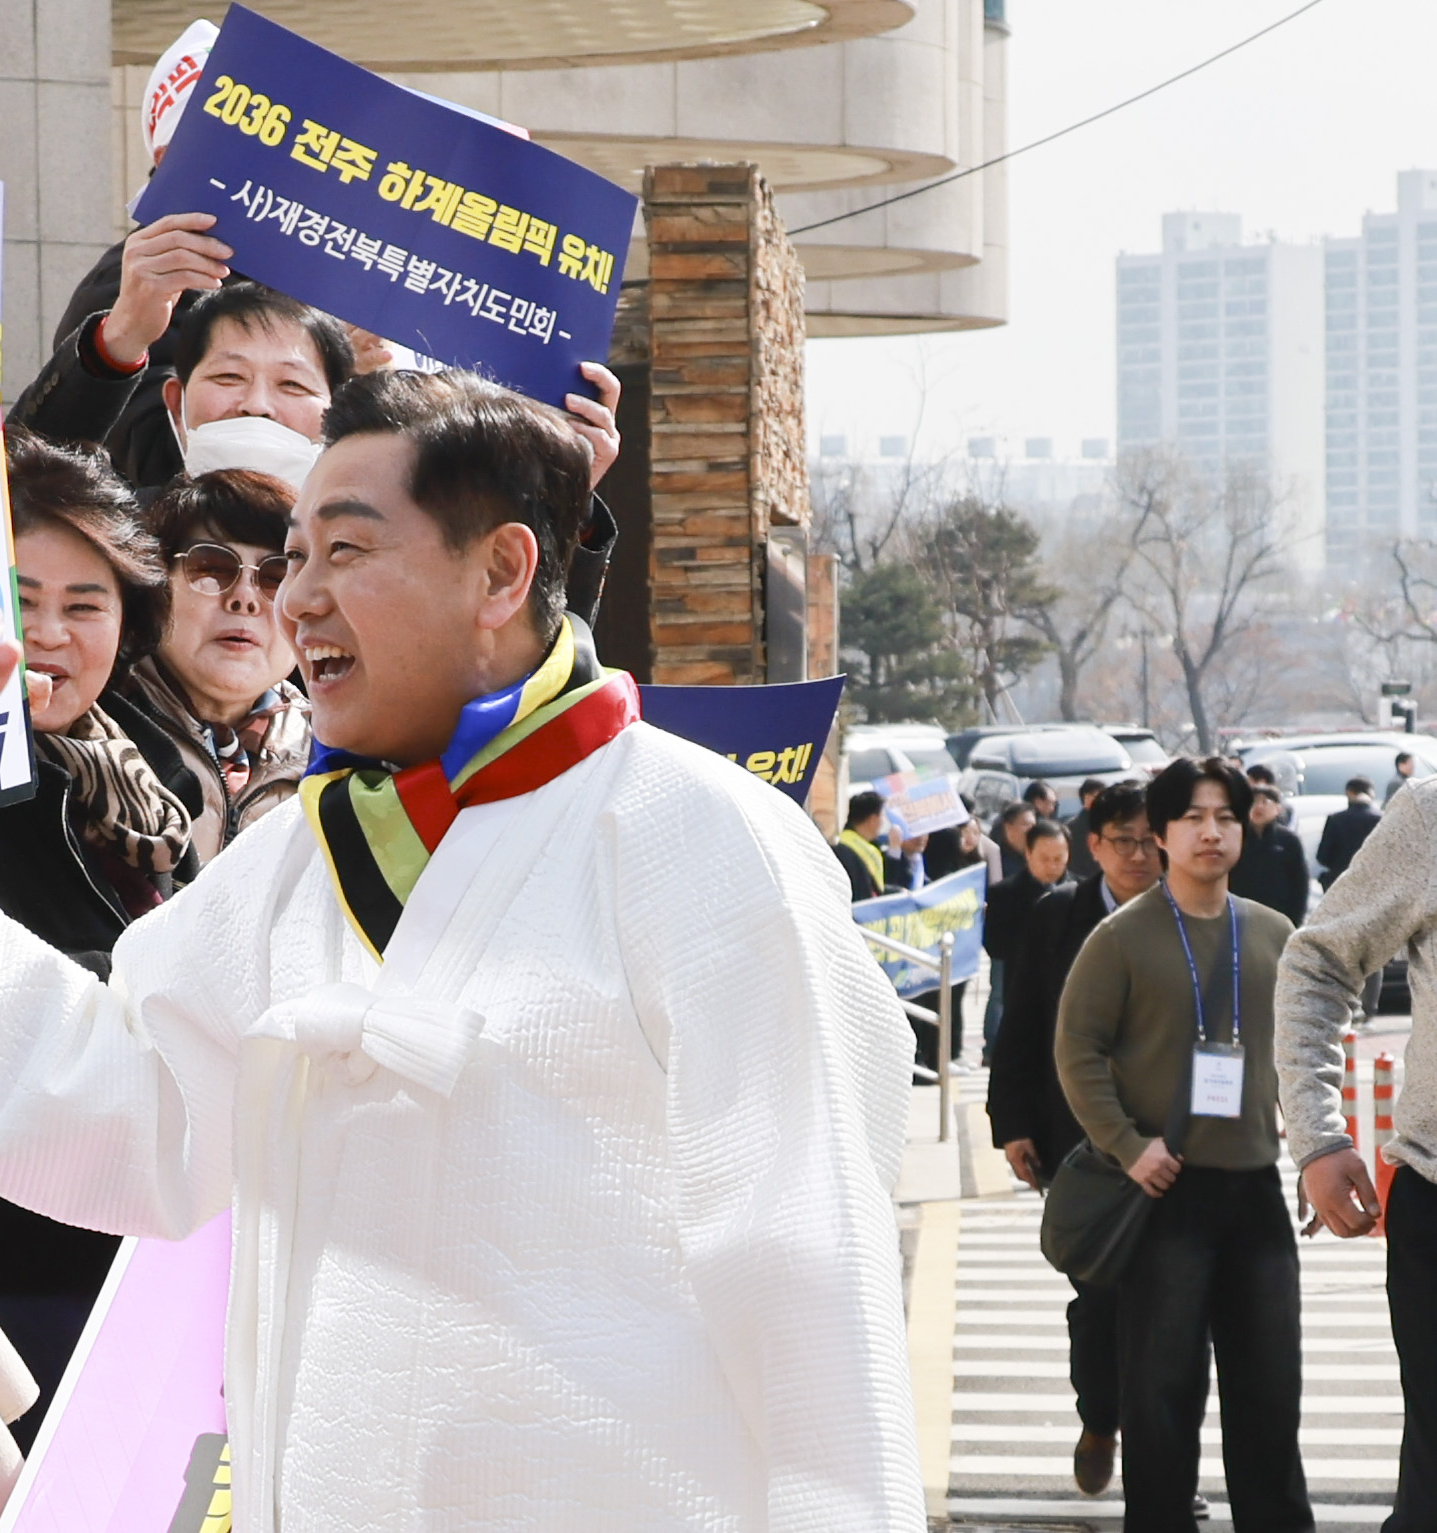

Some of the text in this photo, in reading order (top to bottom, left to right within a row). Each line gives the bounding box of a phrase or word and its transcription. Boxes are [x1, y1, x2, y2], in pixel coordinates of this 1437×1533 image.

[203, 75, 292, 147] 2036
[290, 118, 379, 184] 전주
[378, 161, 558, 267] 하계올림픽
[558, 233, 614, 295] 유치!
